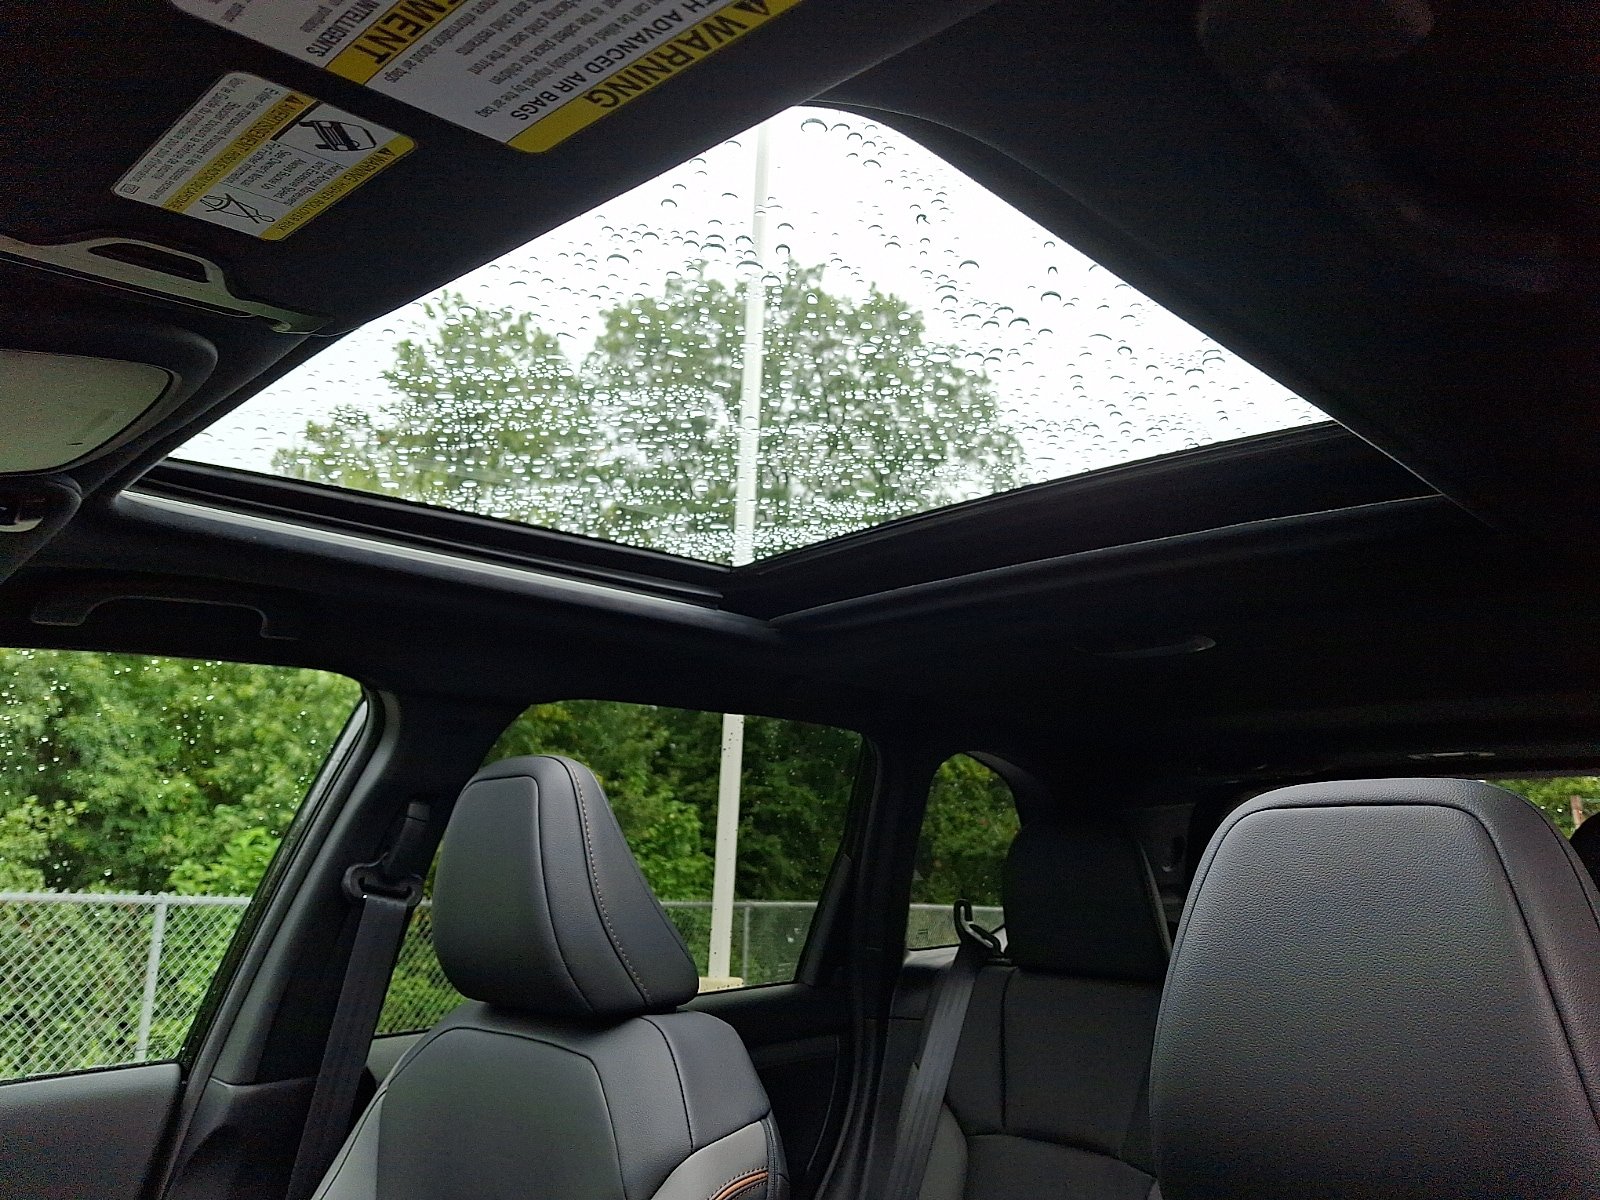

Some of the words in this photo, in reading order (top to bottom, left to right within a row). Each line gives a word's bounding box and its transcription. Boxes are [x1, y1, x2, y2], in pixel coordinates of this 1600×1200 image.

[584, 9, 683, 74] ADVANCED
[582, 15, 748, 108] WARNING
[552, 71, 587, 93] AIR
[474, 106, 500, 118] bag
[510, 90, 560, 121] BAGS
[343, 154, 388, 183] WARNING
